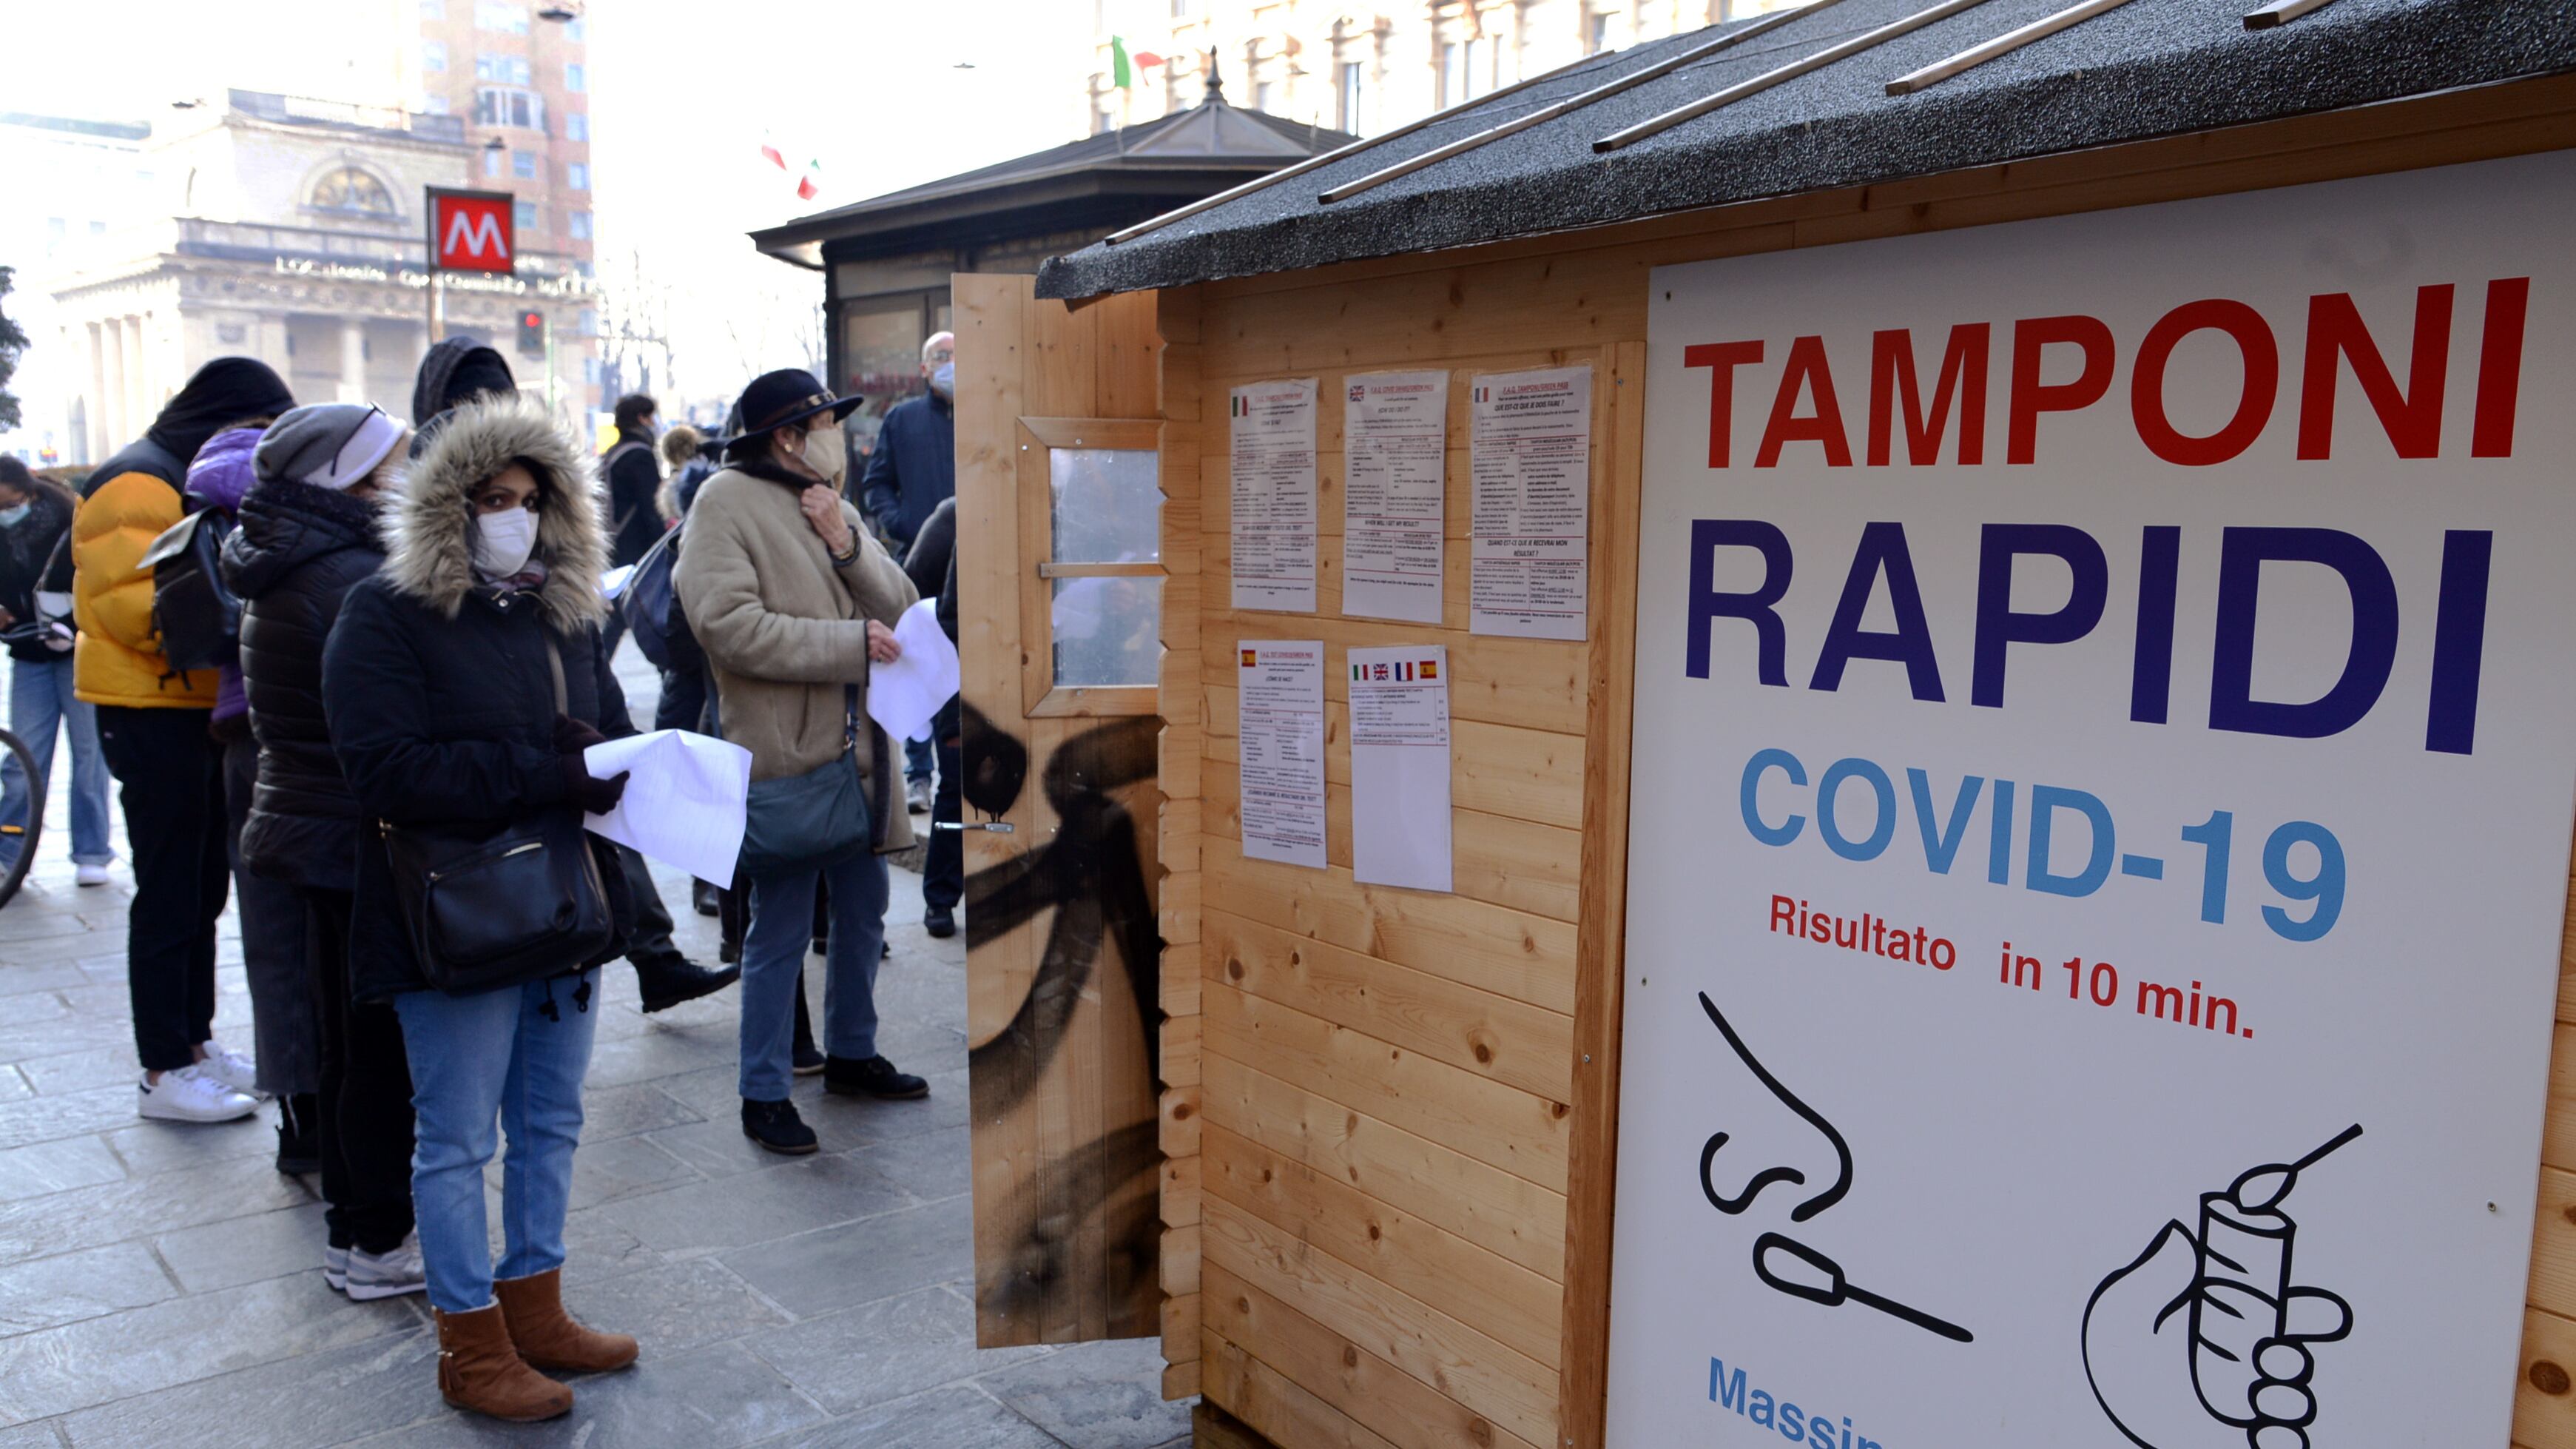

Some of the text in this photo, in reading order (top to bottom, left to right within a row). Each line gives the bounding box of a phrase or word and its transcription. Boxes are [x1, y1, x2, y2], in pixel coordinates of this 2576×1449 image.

[445, 210, 508, 258] M
[1684, 277, 2531, 468] TAMPONI
[1686, 520, 2493, 755] RAPIDI
[1739, 747, 2347, 943] COVID-19
[1770, 894, 2253, 1039] Risultato in 10 min.
